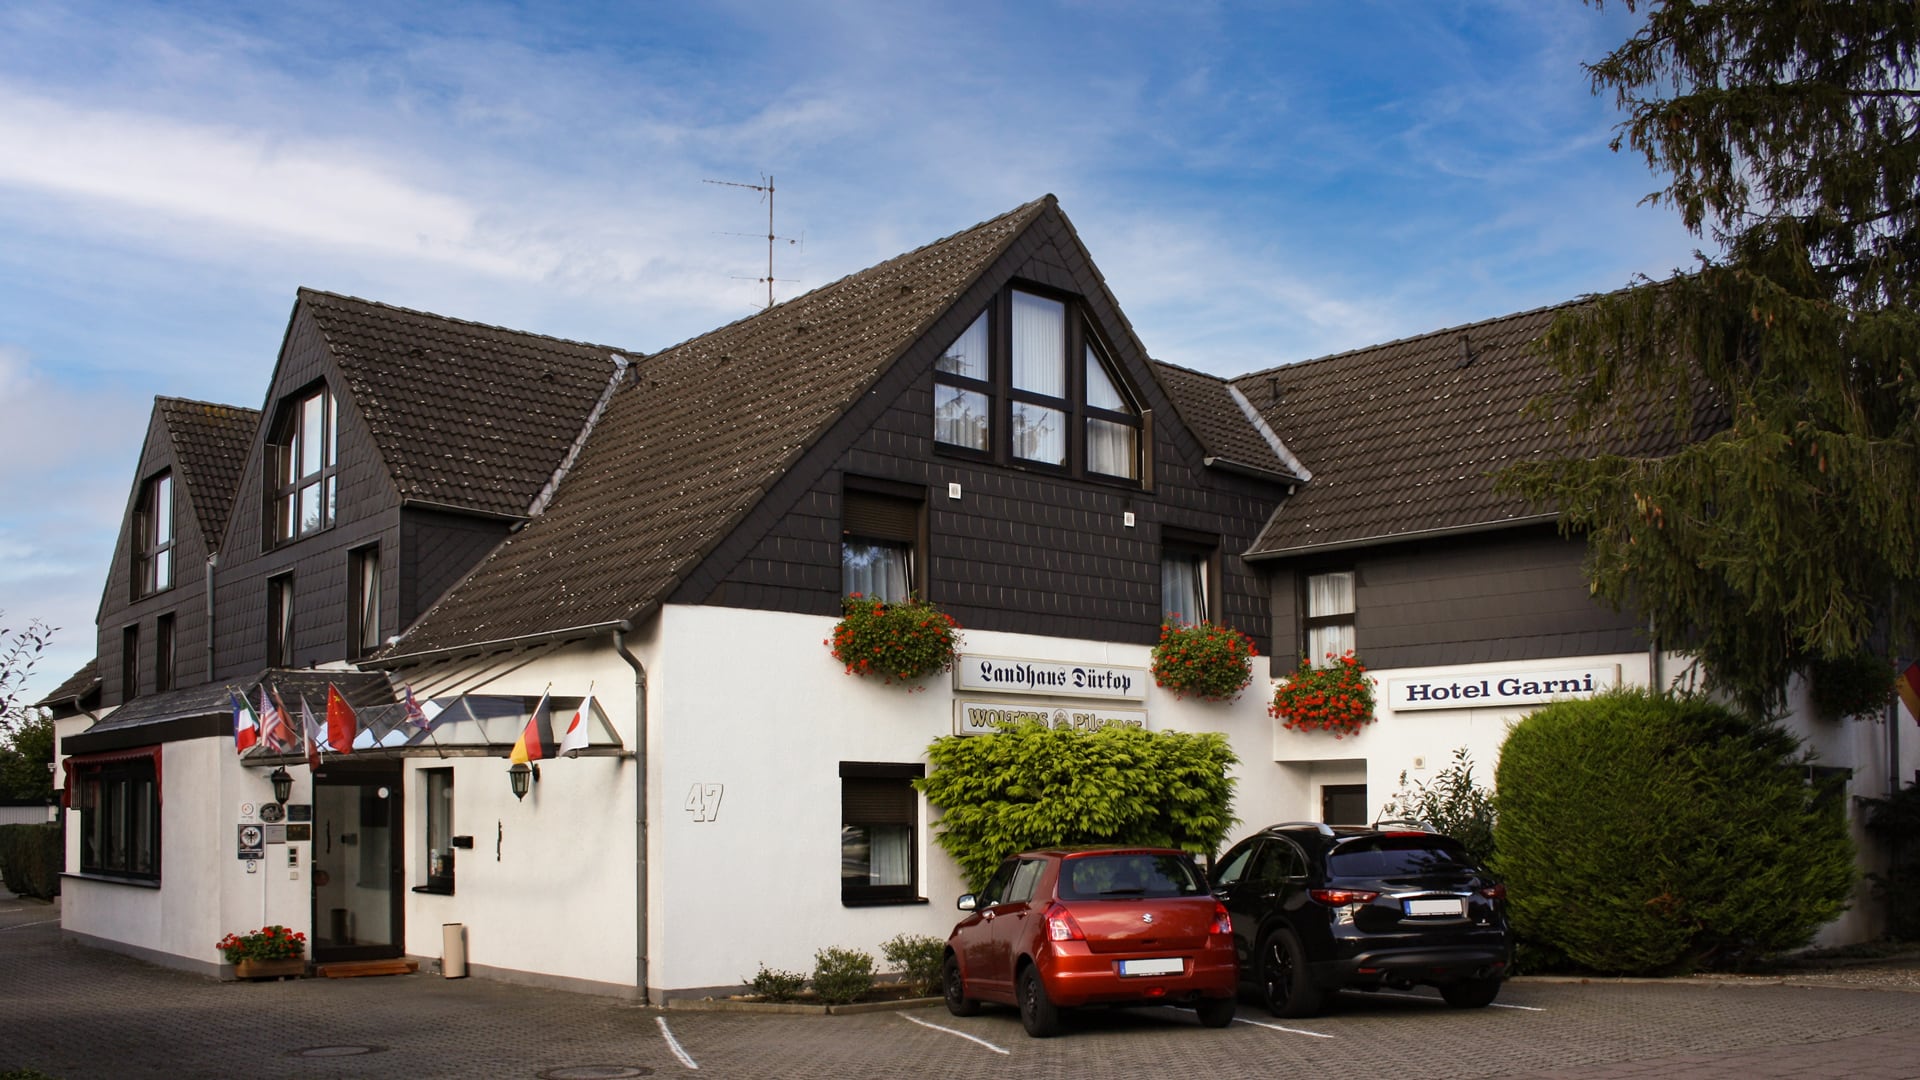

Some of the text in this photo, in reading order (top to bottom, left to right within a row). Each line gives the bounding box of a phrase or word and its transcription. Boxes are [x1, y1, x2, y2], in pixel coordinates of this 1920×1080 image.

[980, 660, 1131, 696] Landhaus Dürkop
[1406, 673, 1594, 701] Hotel Garni
[685, 783, 724, 822] 47
